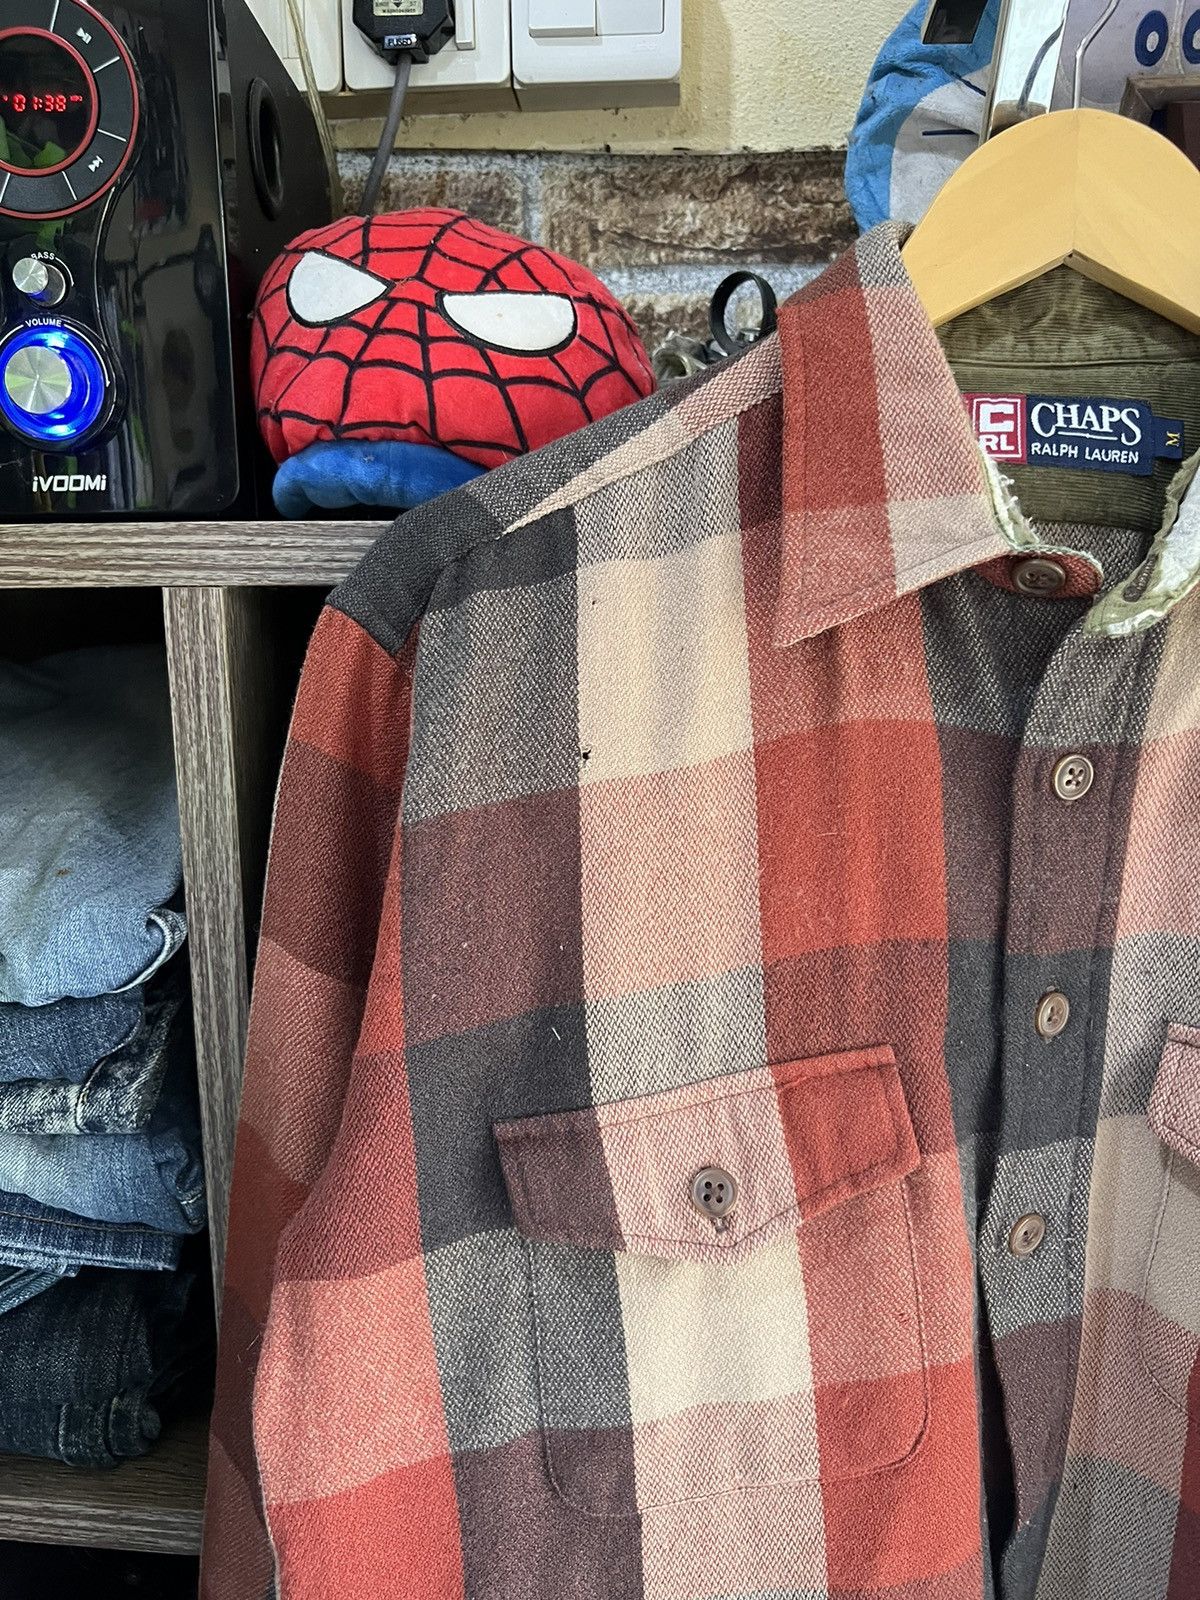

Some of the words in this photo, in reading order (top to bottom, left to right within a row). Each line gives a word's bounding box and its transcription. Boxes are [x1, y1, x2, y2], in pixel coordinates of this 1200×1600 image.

[13, 93, 67, 112] 01:38
[25, 318, 62, 327] VOLUME
[979, 402, 1014, 433] C
[1030, 402, 1142, 446] CHAPS
[978, 434, 1015, 451] RL
[1165, 431, 1181, 447] M
[1031, 442, 1079, 459] RALPH
[1085, 446, 1139, 464] LAUREN
